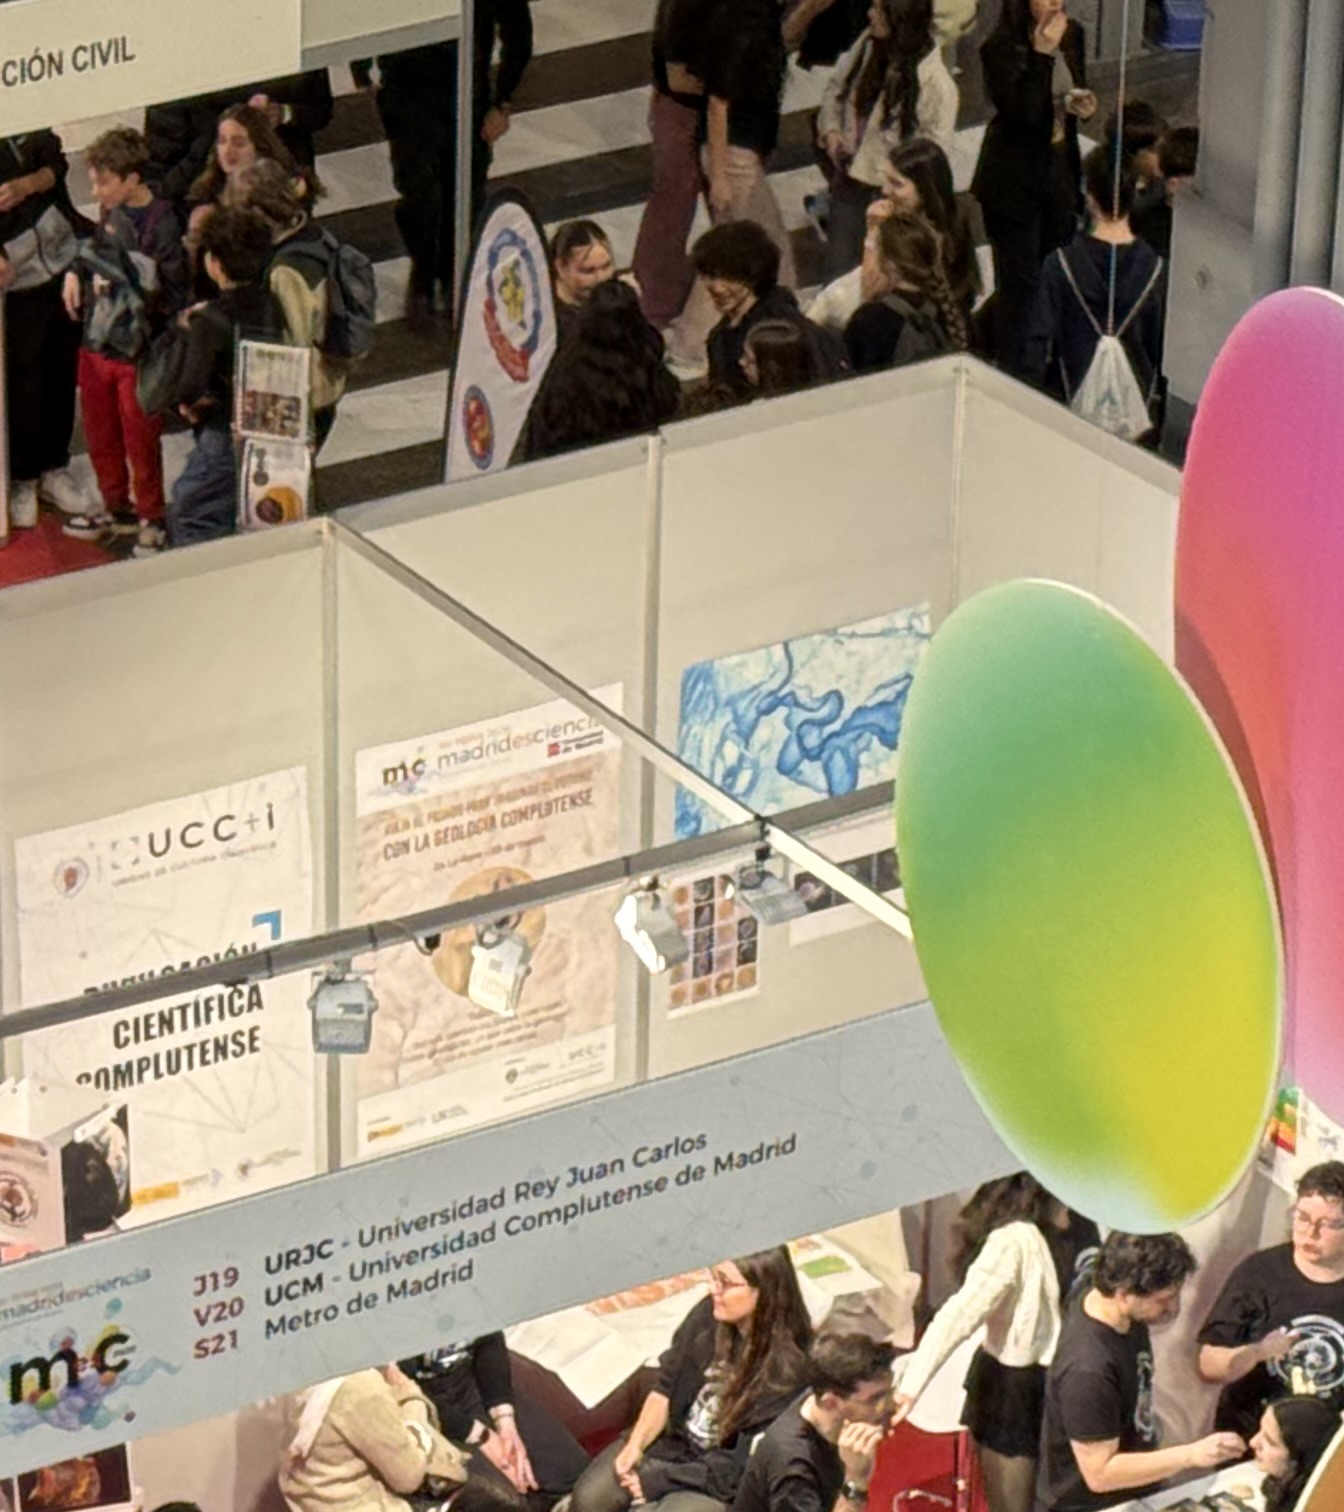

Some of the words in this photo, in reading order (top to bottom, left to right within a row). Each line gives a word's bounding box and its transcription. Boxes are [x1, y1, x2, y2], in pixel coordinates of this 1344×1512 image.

[71, 34, 137, 73] CIVIL
[383, 840, 411, 862] CON
[414, 833, 431, 852] LA
[500, 786, 594, 830] COMPLUTENSE
[112, 982, 265, 1050] CIENTÍFICA
[192, 1266, 240, 1298] J19
[264, 1238, 334, 1276] URJC
[358, 1186, 506, 1249] Universidad
[514, 1173, 561, 1205] Rey
[565, 1156, 625, 1188] Juan
[631, 1132, 708, 1168] Carlos
[192, 1295, 245, 1328] V20
[264, 1272, 324, 1307] UCM
[348, 1220, 497, 1284] Universidad
[504, 1174, 669, 1237] Complutense
[674, 1163, 707, 1187] de
[712, 1132, 798, 1177] Madrid
[192, 1329, 240, 1360] S21
[264, 1303, 339, 1340] Metro
[346, 1291, 380, 1315] de
[386, 1258, 474, 1304] Madrid
